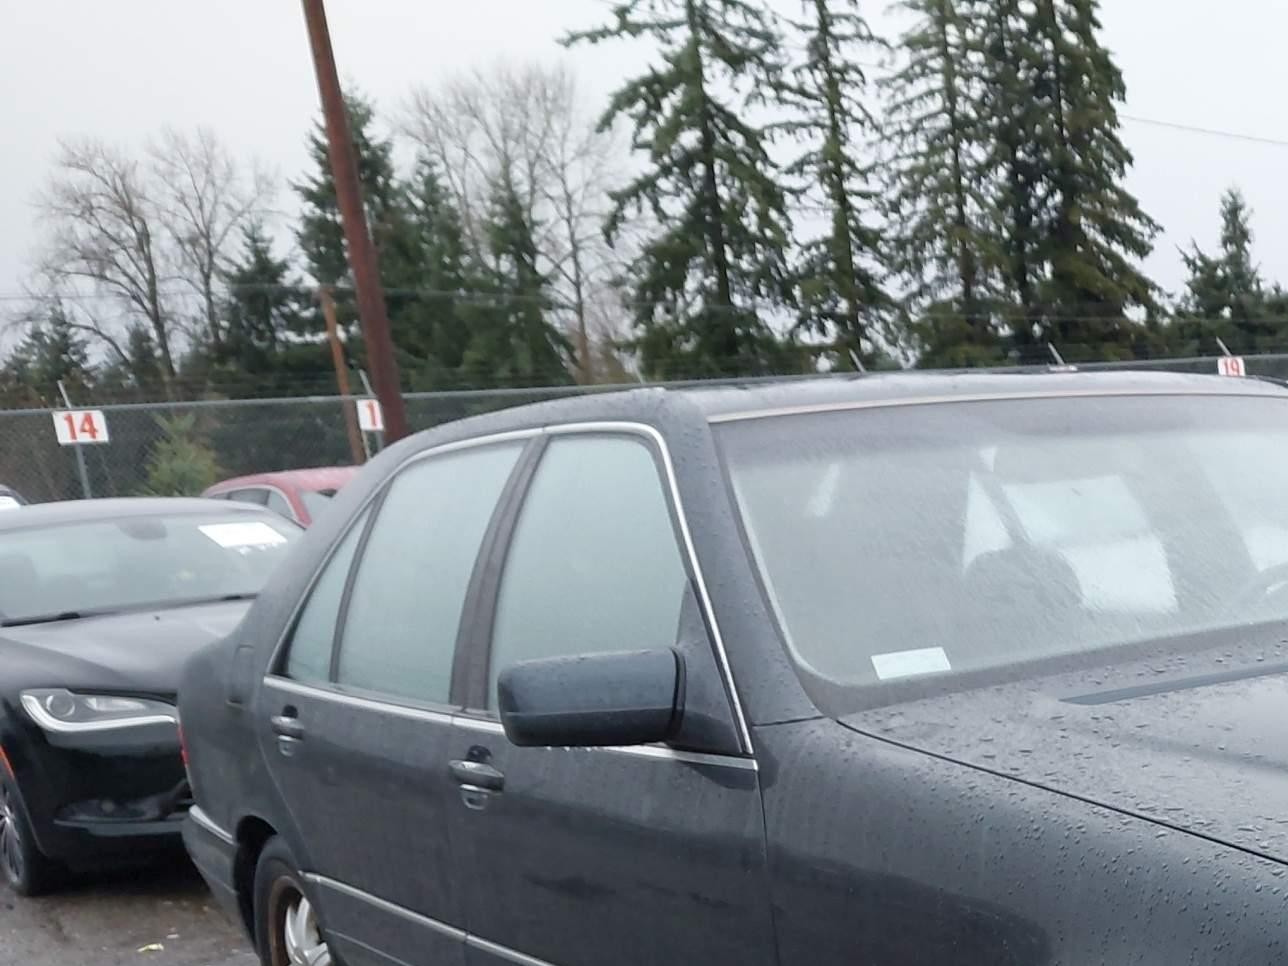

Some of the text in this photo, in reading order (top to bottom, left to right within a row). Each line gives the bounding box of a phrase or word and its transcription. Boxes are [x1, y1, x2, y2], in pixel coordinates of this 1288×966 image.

[1223, 358, 1240, 376] 19
[367, 400, 377, 427] 1
[64, 413, 98, 442] 14
